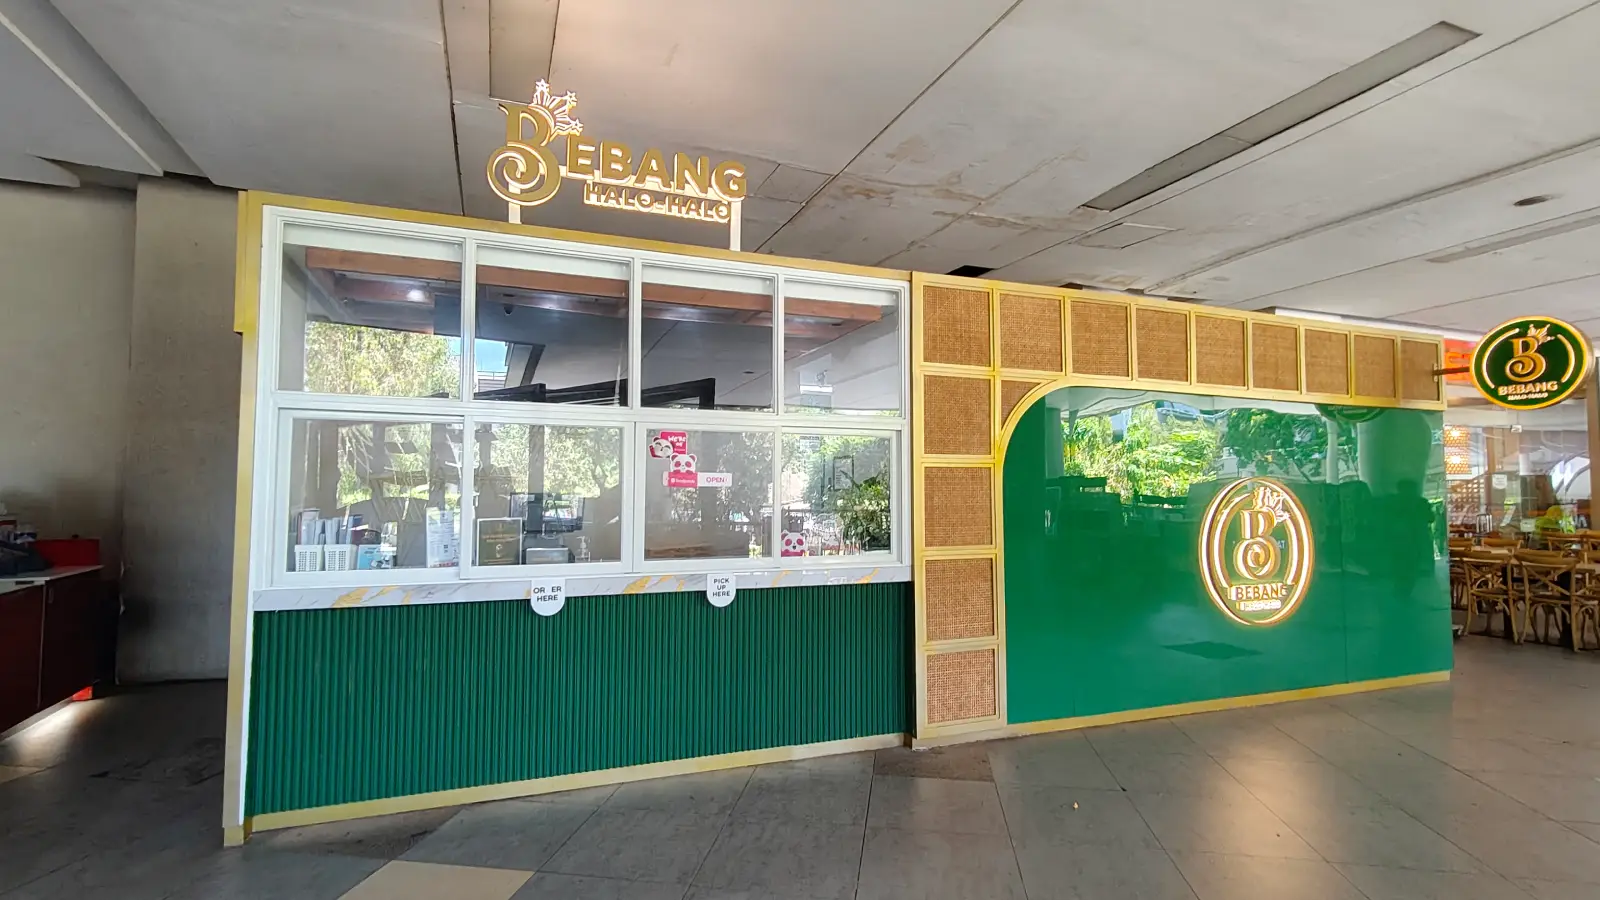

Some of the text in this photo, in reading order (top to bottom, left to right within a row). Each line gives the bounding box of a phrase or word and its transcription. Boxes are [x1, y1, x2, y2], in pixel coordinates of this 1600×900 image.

[487, 103, 747, 206] BEBANG
[584, 183, 731, 223] HALO-HALO
[1498, 381, 1559, 396] BEBANG
[536, 594, 559, 603] HERE
